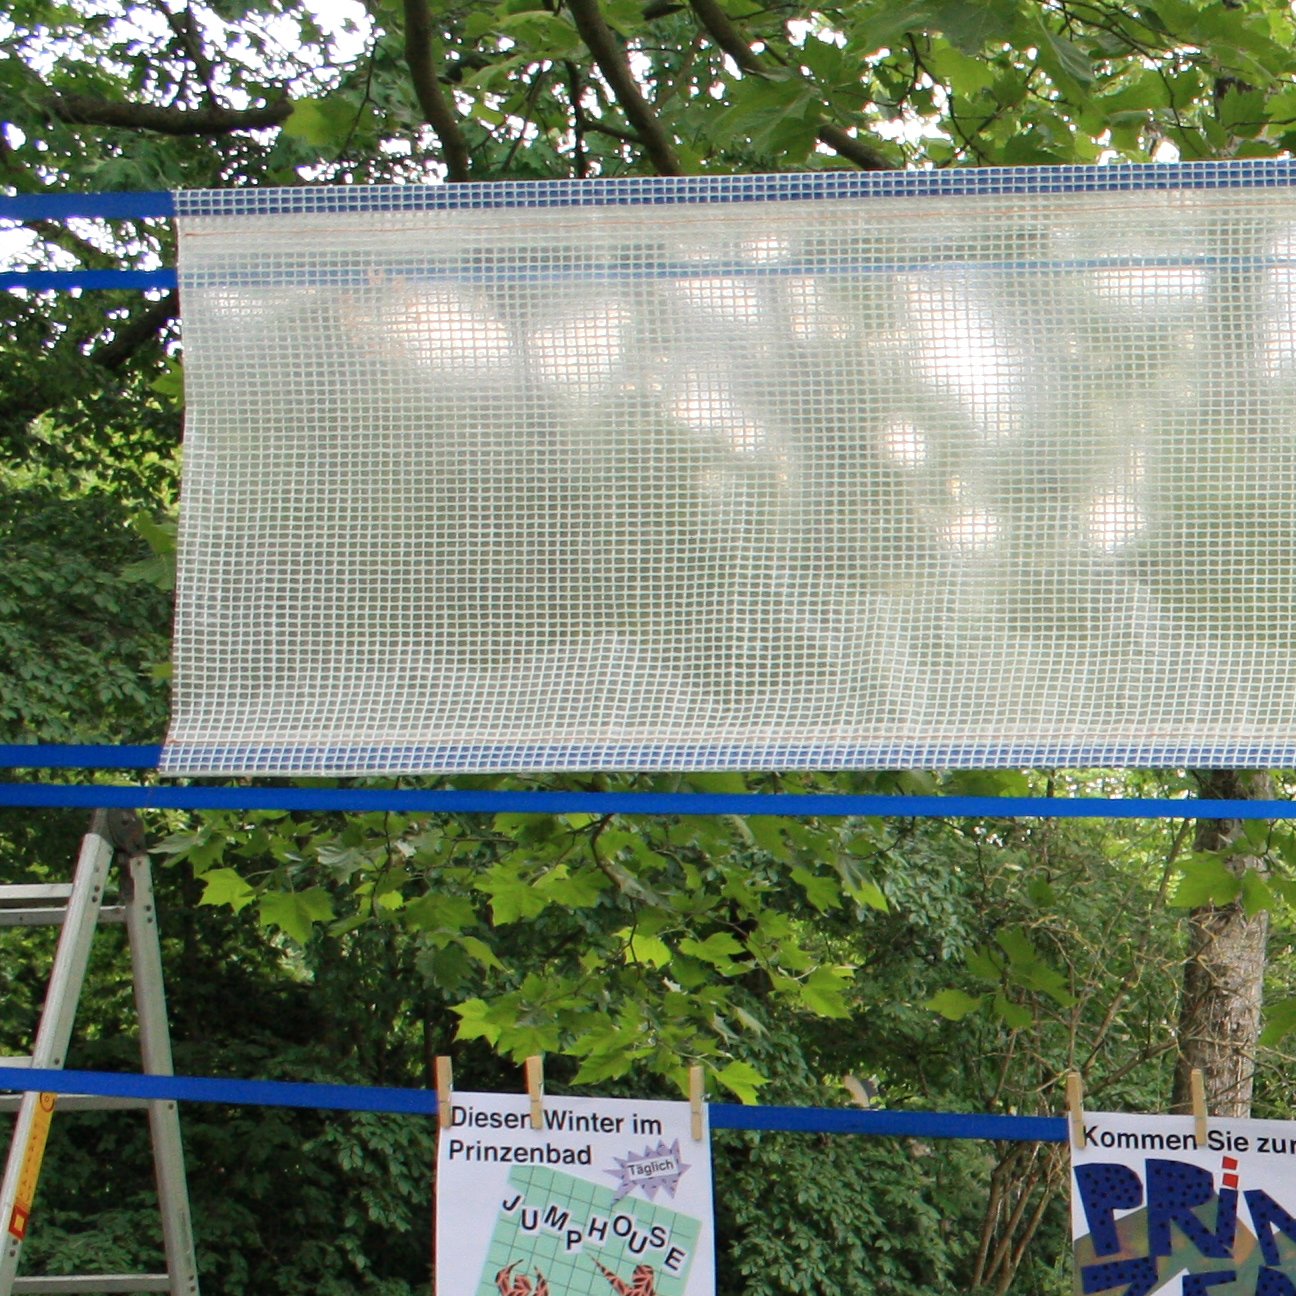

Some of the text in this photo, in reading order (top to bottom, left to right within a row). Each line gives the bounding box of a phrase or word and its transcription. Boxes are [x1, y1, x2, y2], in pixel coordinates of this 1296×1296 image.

[543, 1109, 625, 1134] Winter
[632, 1113, 662, 1136] im
[448, 1139, 592, 1166] Prinzenbad
[1083, 1126, 1197, 1151] Kommen
[1207, 1130, 1249, 1152] Sie
